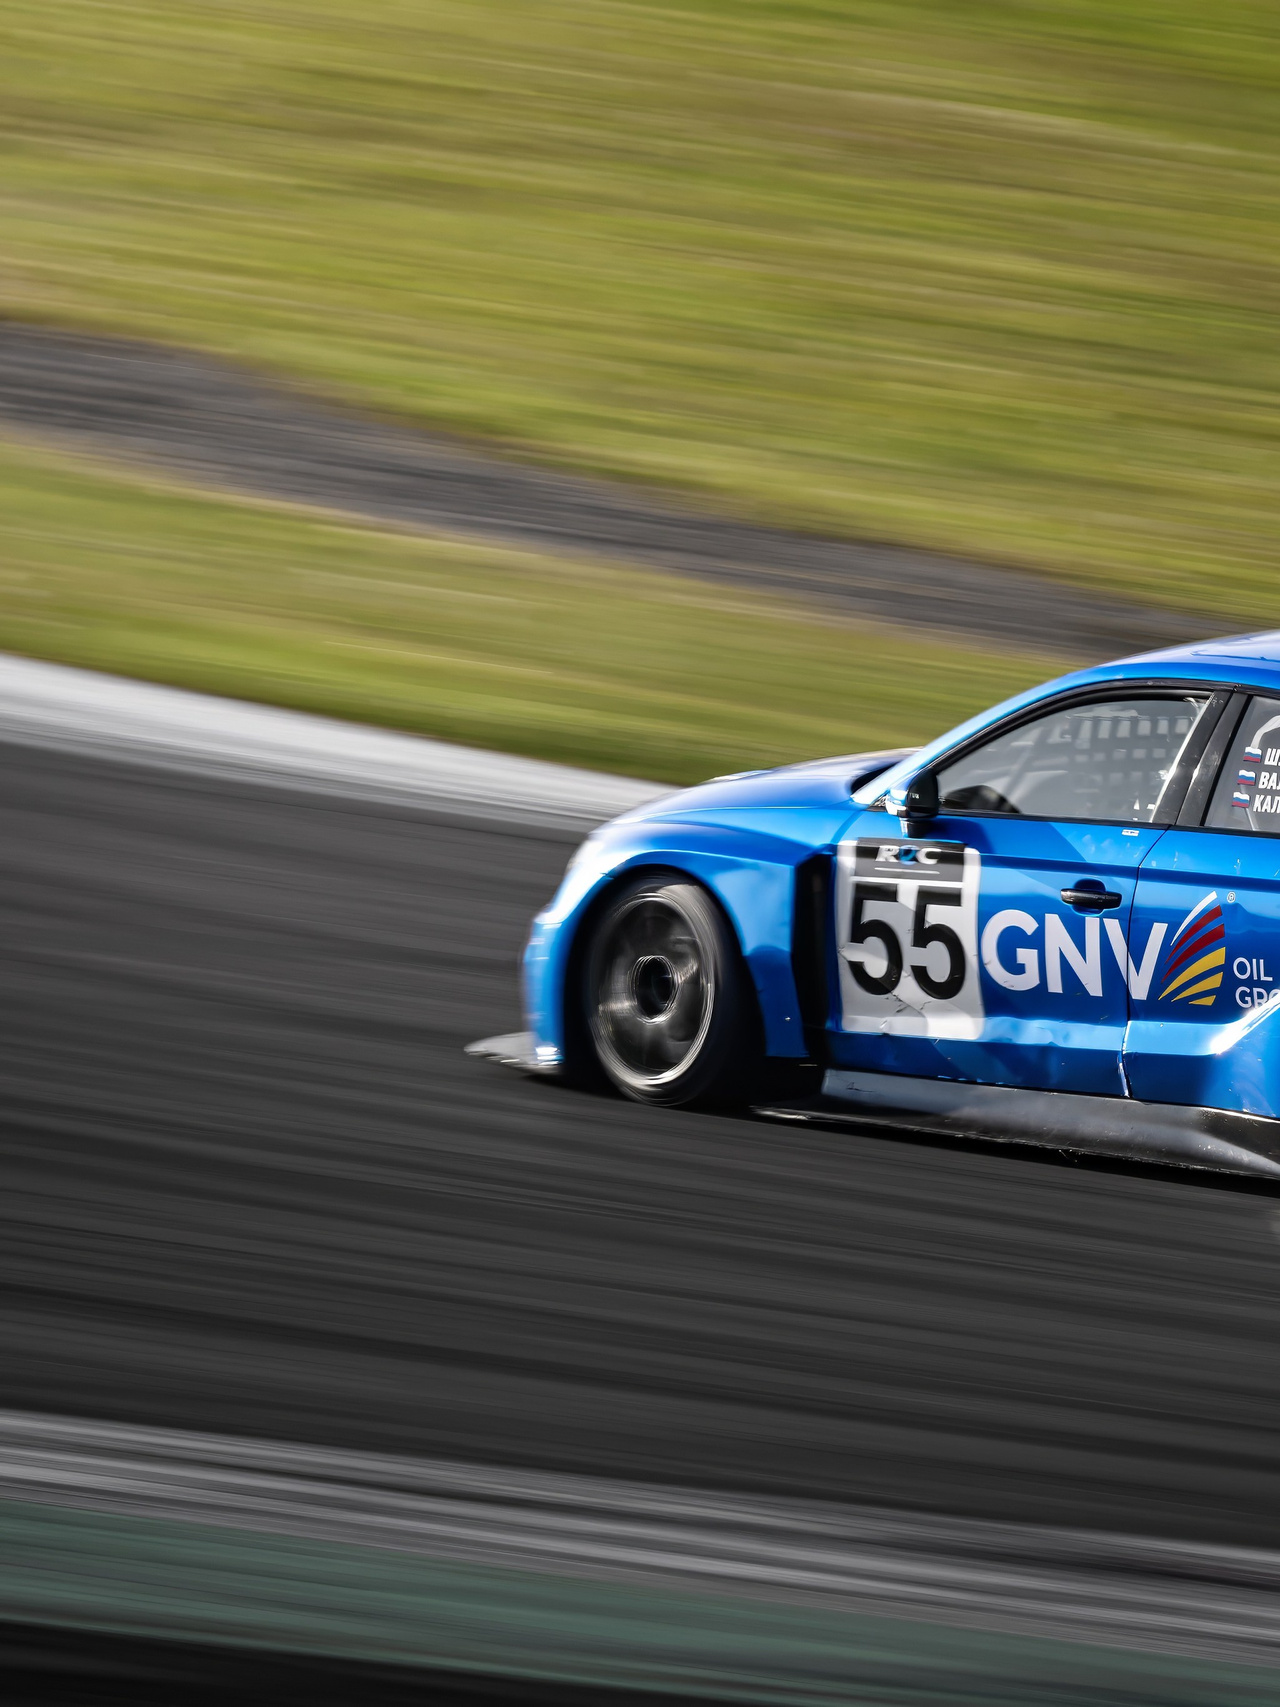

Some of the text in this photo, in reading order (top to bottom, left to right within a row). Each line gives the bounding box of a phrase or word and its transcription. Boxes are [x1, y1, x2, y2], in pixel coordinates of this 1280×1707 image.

[847, 881, 967, 1001] 55
[981, 908, 1168, 1000] GNV
[1233, 957, 1273, 981] OIL
